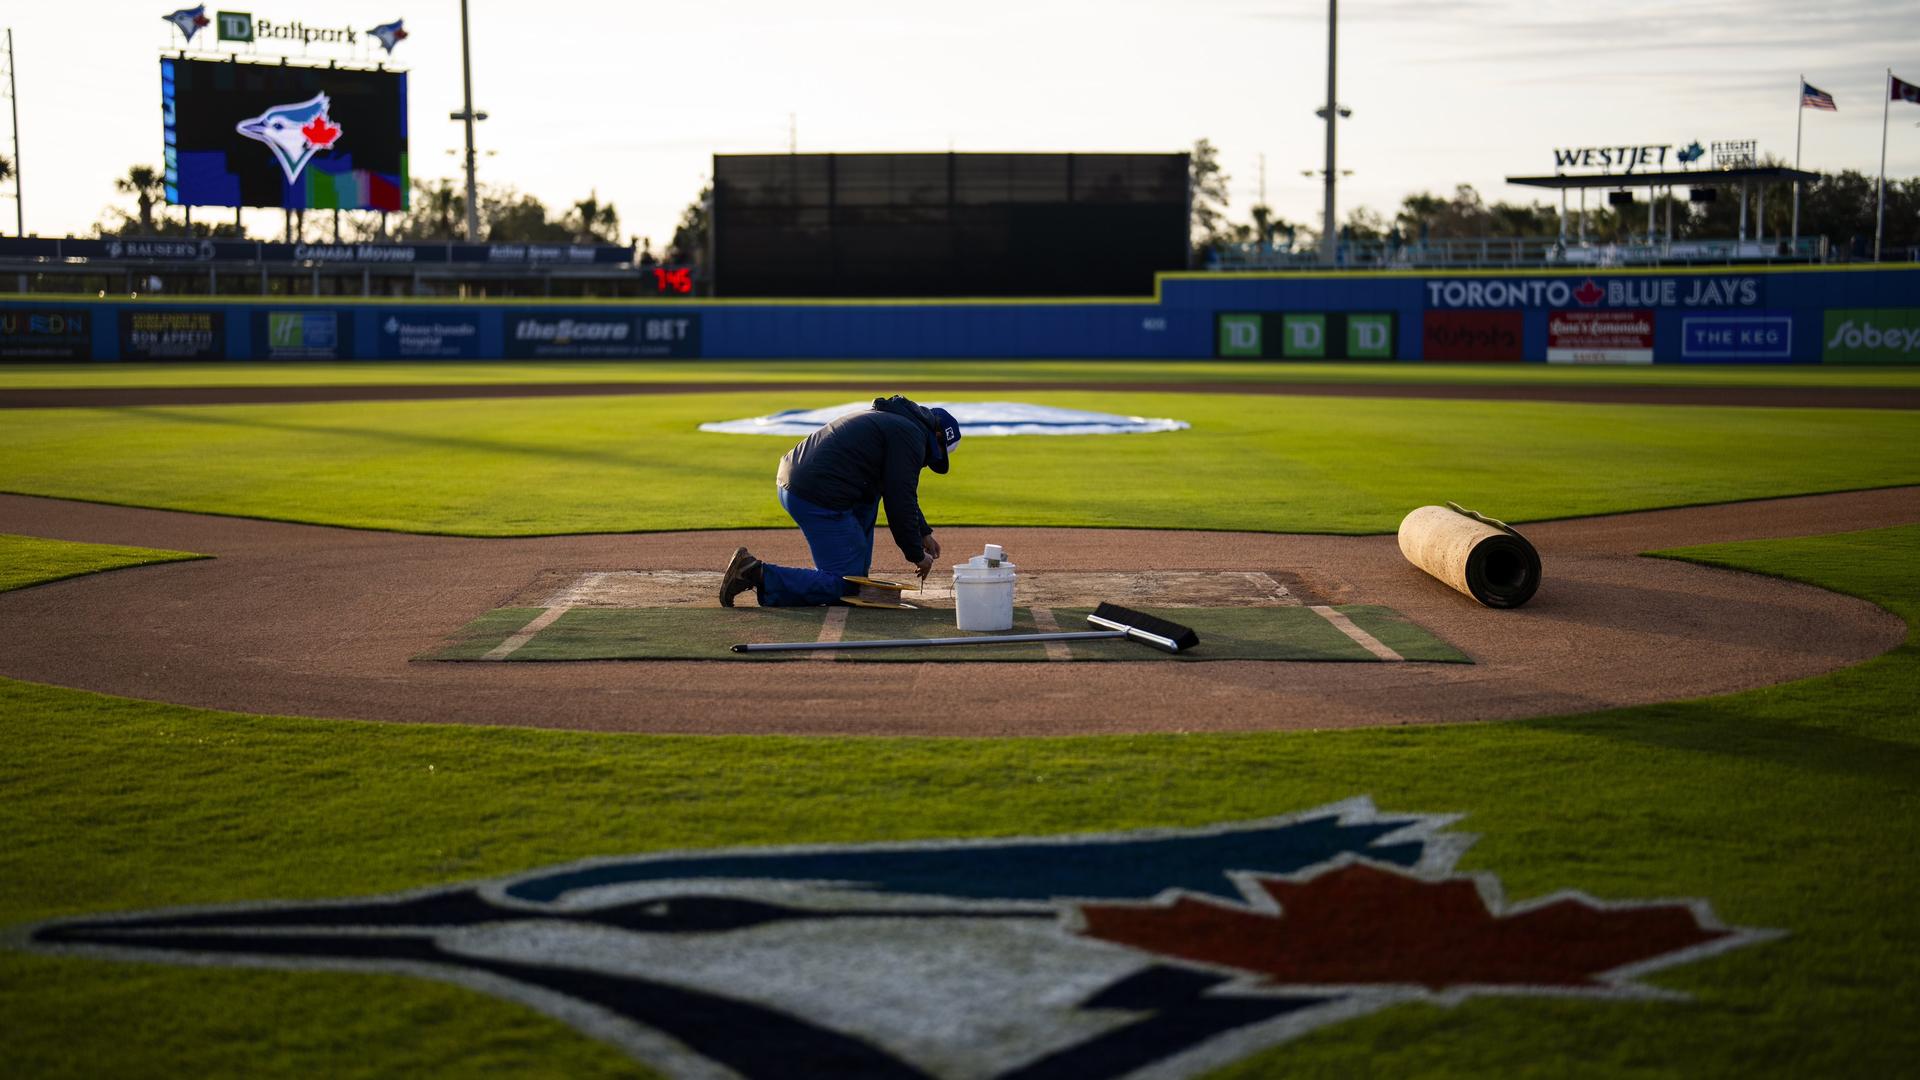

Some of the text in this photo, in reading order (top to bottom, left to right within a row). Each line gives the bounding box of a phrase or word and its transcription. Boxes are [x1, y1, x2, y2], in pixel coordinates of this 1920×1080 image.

[221, 15, 356, 46] TD Ballpark
[1553, 144, 1672, 172] WESTJET
[1426, 277, 1758, 308] TORONTO BLUE JAYS
[515, 317, 690, 341] theScore BET
[1225, 321, 1258, 348] TD
[1288, 321, 1321, 348] TD
[1353, 321, 1386, 348] TD
[1693, 328, 1780, 345] THE KEG
